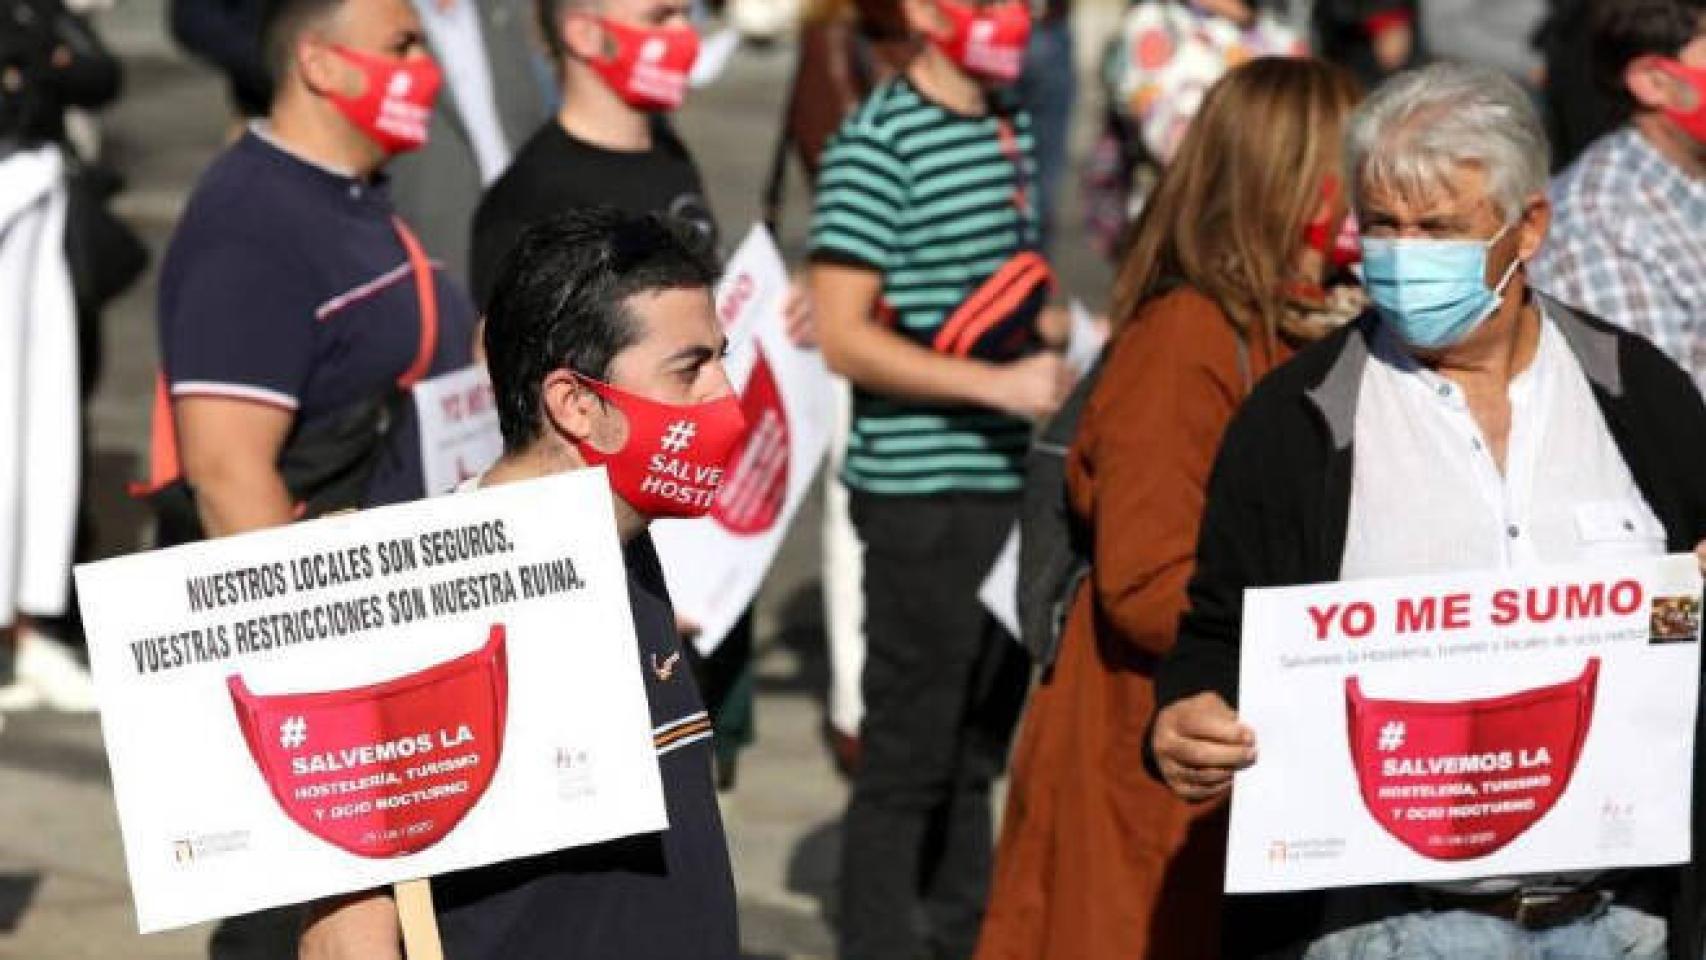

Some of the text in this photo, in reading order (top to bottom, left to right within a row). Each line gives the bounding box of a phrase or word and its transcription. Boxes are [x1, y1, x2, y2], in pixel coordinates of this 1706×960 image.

[661, 420, 695, 452] #
[186, 561, 286, 612] NUESTROS
[289, 544, 373, 592] LOCALES
[377, 537, 418, 576] SON
[129, 557, 587, 674] VUESTRAS RESTRICCIONES SON NUESTRA RUINA.
[1307, 577, 1644, 642] YO ME SUMO
[279, 715, 308, 749] #
[1378, 721, 1407, 751] #
[292, 723, 475, 777] SALVEMOS LA
[406, 752, 481, 780] TURISMO
[1382, 746, 1552, 777] SALVEMOS LA
[315, 780, 469, 823] Y OCIO NOCTURNO
[1392, 798, 1536, 821] Y OCIO NOCTURNO
